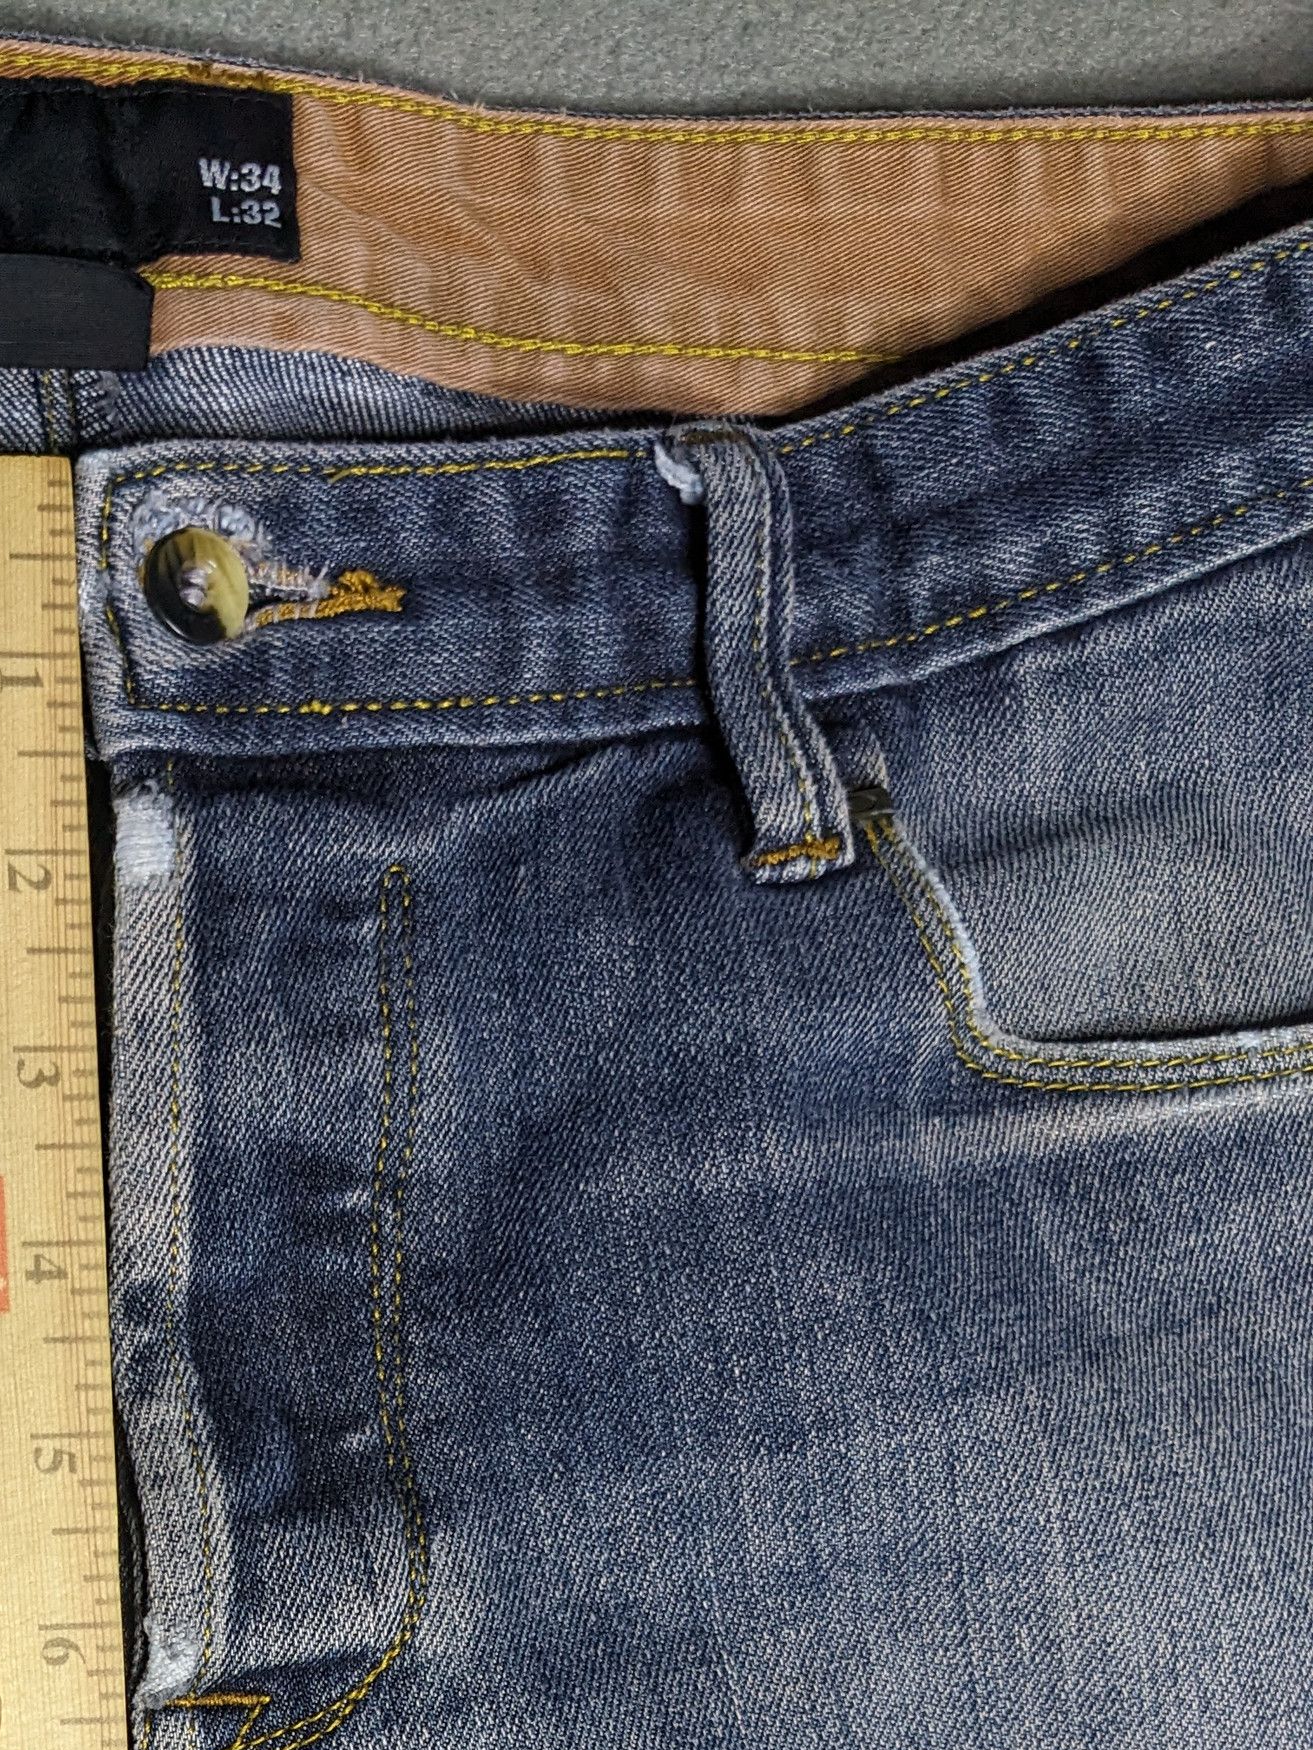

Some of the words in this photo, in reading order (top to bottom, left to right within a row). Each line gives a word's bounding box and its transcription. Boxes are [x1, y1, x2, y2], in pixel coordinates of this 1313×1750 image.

[199, 158, 282, 195] W:34
[211, 196, 282, 229] L:32
[0, 667, 44, 694] 1
[7, 865, 51, 893] 2
[16, 1059, 61, 1089] 3
[25, 1254, 69, 1284] 4
[34, 1446, 77, 1475] 5
[42, 1638, 87, 1665] 6
